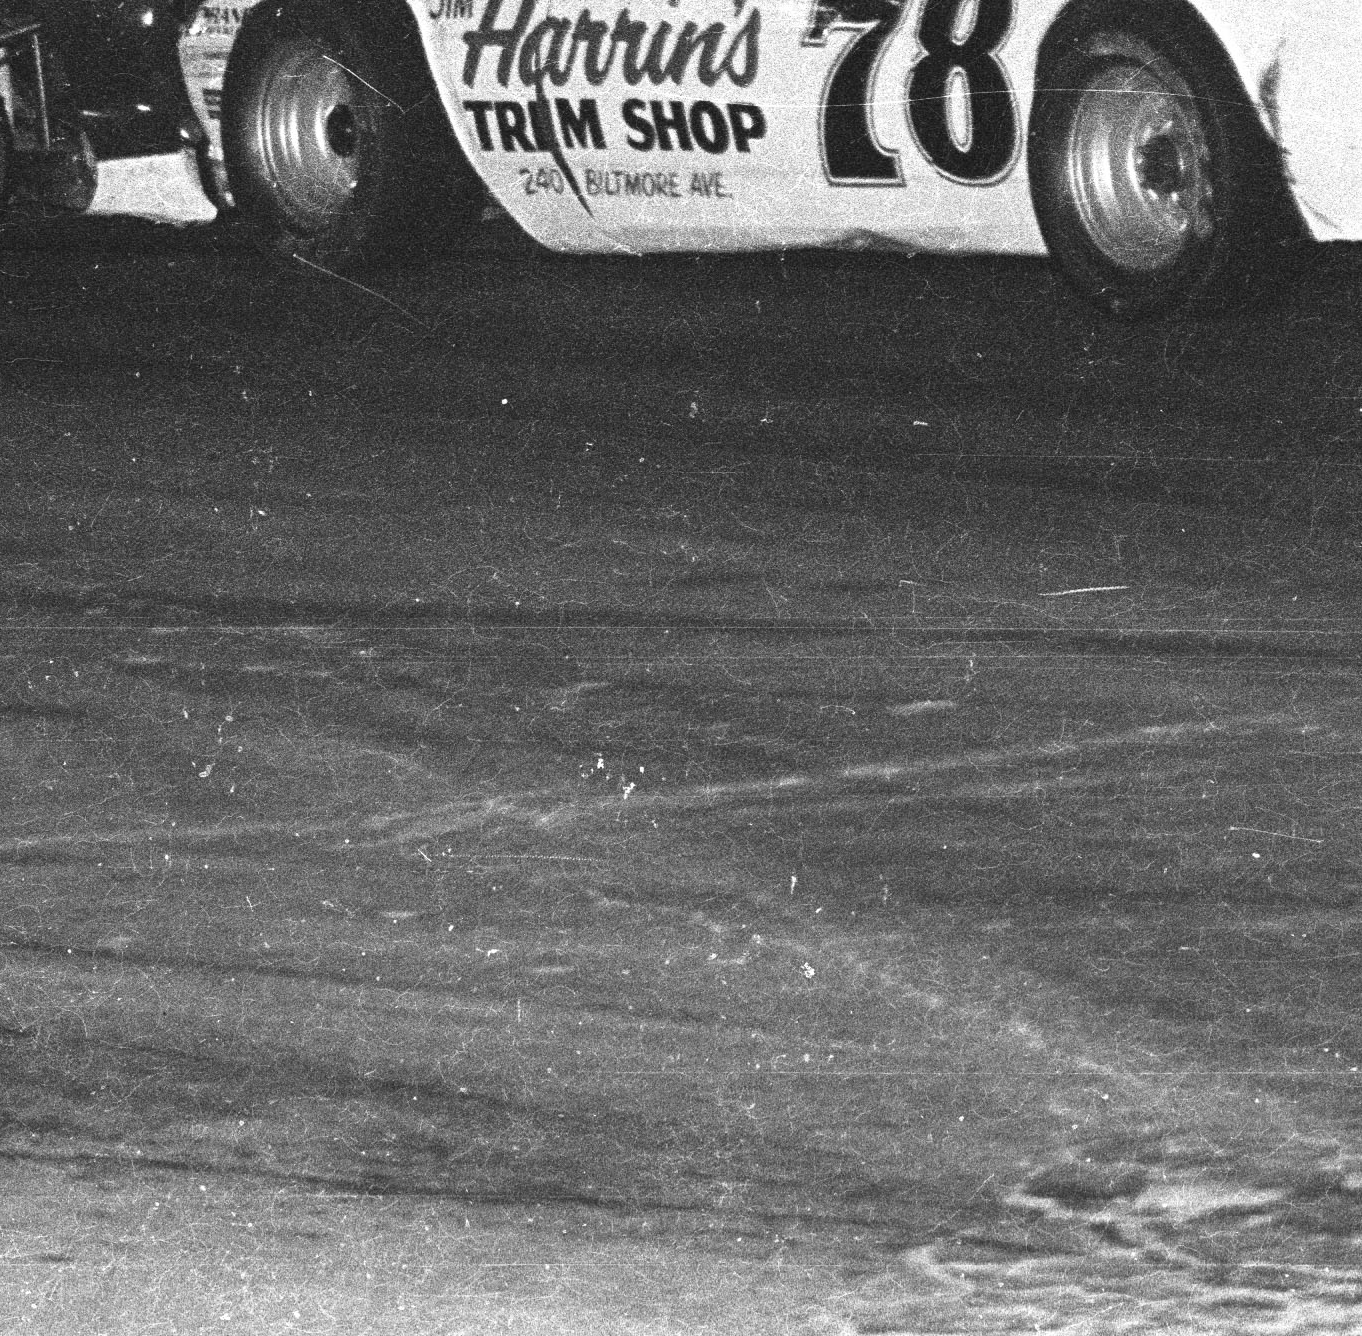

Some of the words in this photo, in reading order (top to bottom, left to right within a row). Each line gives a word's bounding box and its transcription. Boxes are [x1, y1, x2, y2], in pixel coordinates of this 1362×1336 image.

[463, 98, 606, 153] TRIM
[621, 98, 767, 154] SHOP
[518, 168, 565, 196] 240
[586, 170, 682, 198] BILTMORE
